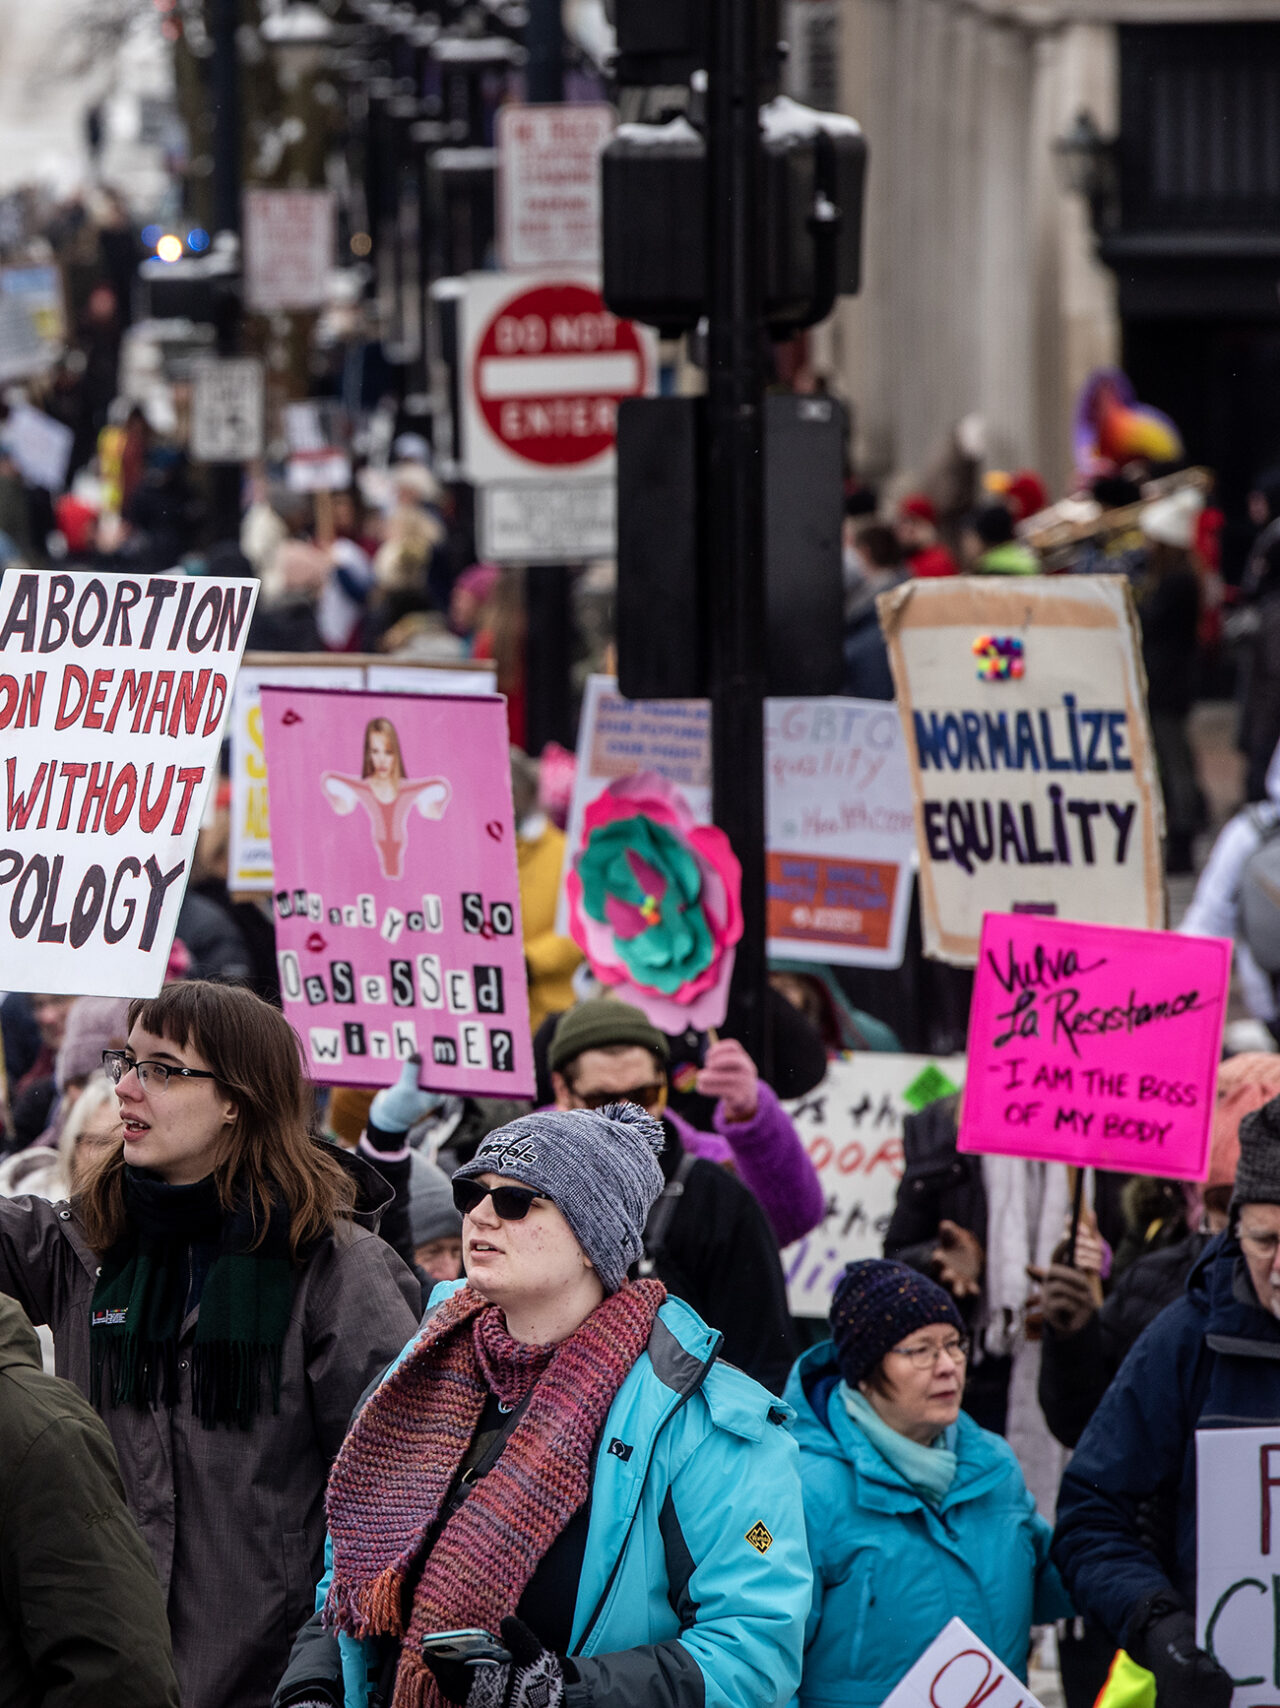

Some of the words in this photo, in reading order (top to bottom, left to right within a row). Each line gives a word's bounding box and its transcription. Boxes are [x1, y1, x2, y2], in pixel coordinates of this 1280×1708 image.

[495, 314, 547, 353] DO
[550, 312, 617, 351] NOT
[500, 399, 616, 440] ENTER
[54, 664, 228, 738] DEMAND
[5, 757, 205, 836] WITHOUT
[987, 939, 1107, 993] Vulva
[1033, 1065, 1073, 1090] AM
[1081, 1067, 1128, 1098] THE
[1138, 1074, 1198, 1108] BOSS
[1004, 1101, 1042, 1127] OF
[1054, 1105, 1095, 1137] MY
[1103, 1112, 1174, 1147] BODY
